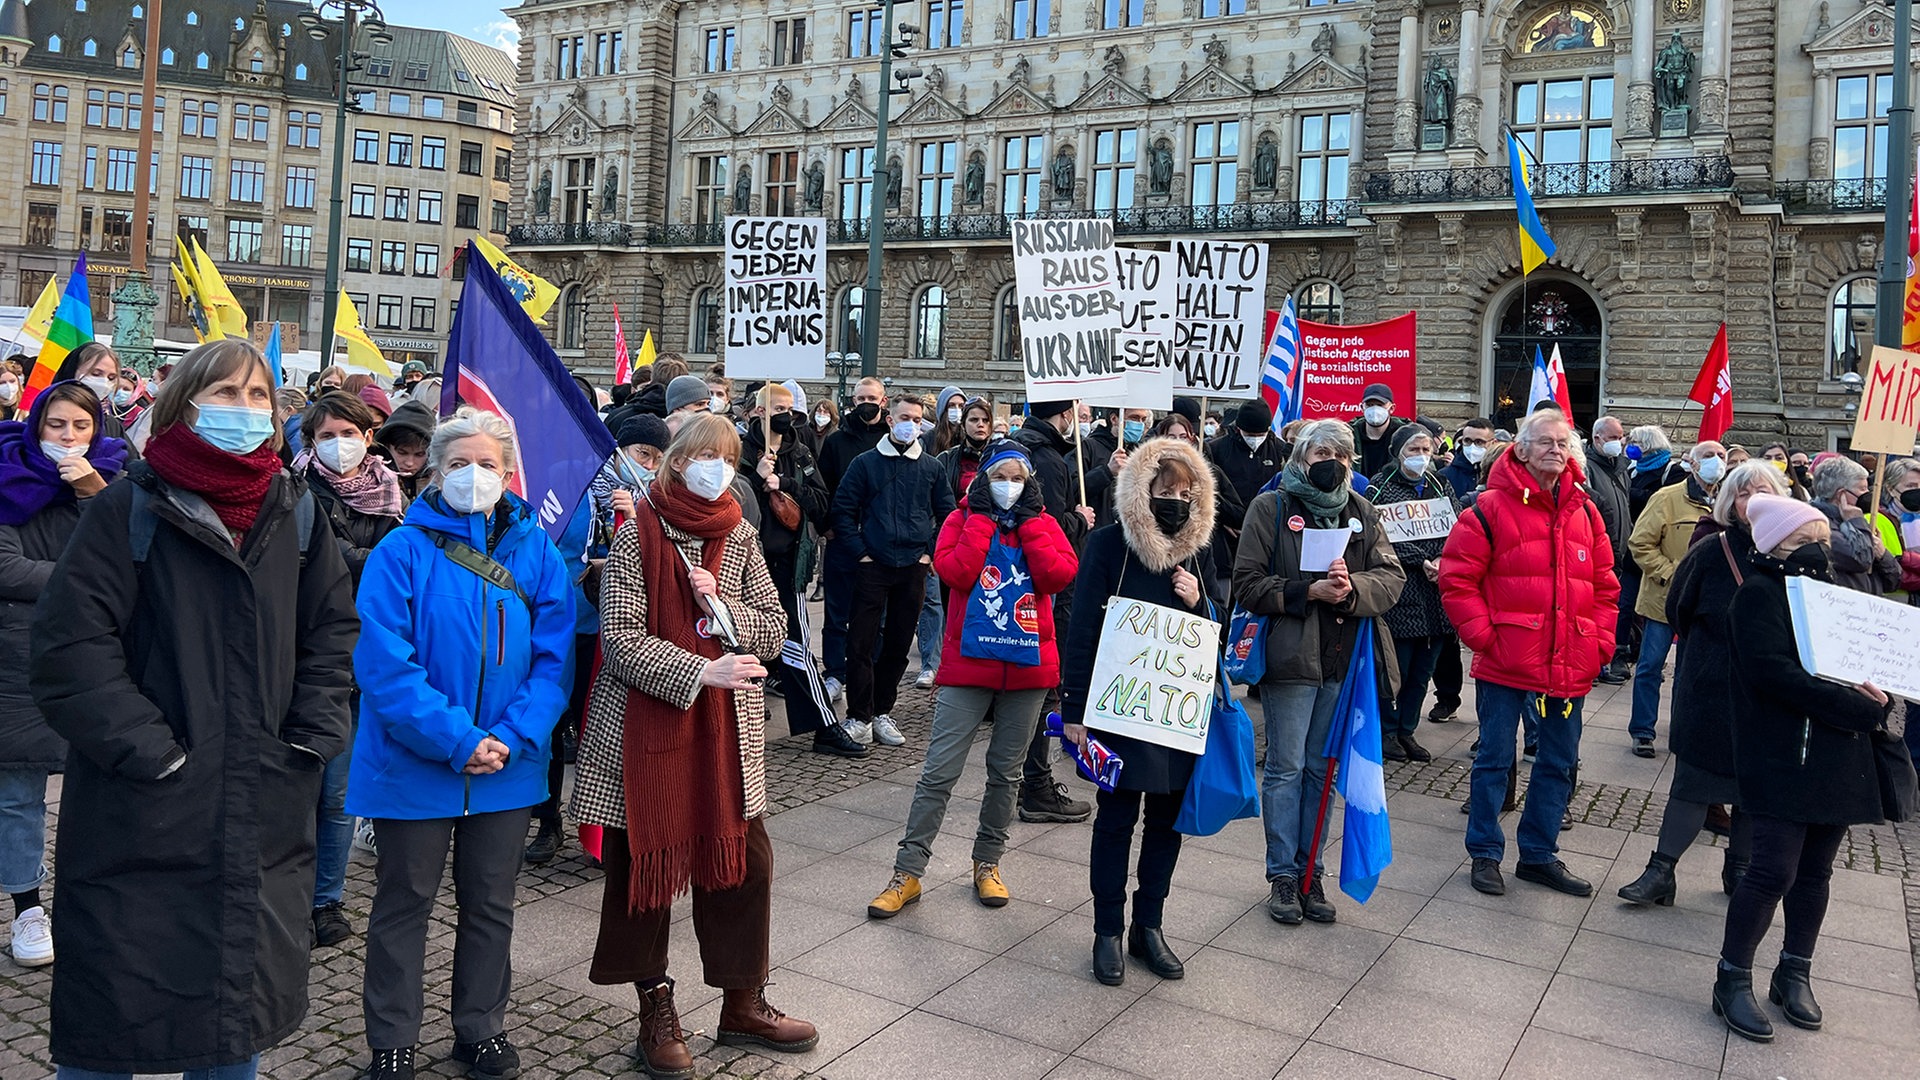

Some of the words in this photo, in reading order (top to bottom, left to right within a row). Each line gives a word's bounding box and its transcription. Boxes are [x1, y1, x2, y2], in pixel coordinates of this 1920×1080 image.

[731, 219, 818, 251] GEGEN
[1015, 221, 1114, 256] RUSSLAND
[730, 253, 816, 279] JEDEN
[1041, 255, 1109, 287] RAUS
[1177, 241, 1259, 280] NATO
[264, 277, 310, 288] HAMBURG
[729, 281, 825, 314] IMPERIA-
[1177, 283, 1253, 319] HALT
[728, 313, 823, 347] LISMUS
[1175, 322, 1244, 352] DEIN
[1305, 335, 1339, 348] Gegen
[1341, 336, 1364, 348] jede
[1024, 328, 1126, 379] UKRAINE
[1303, 361, 1318, 371] die
[1321, 361, 1392, 373] sozialistische
[1351, 348, 1410, 361] Aggression
[1174, 351, 1250, 390] MAUL
[1306, 374, 1364, 385] Revolution!
[1115, 602, 1202, 648] RAUS
[1128, 646, 1187, 677] AUS
[1096, 673, 1212, 737] NATO!
